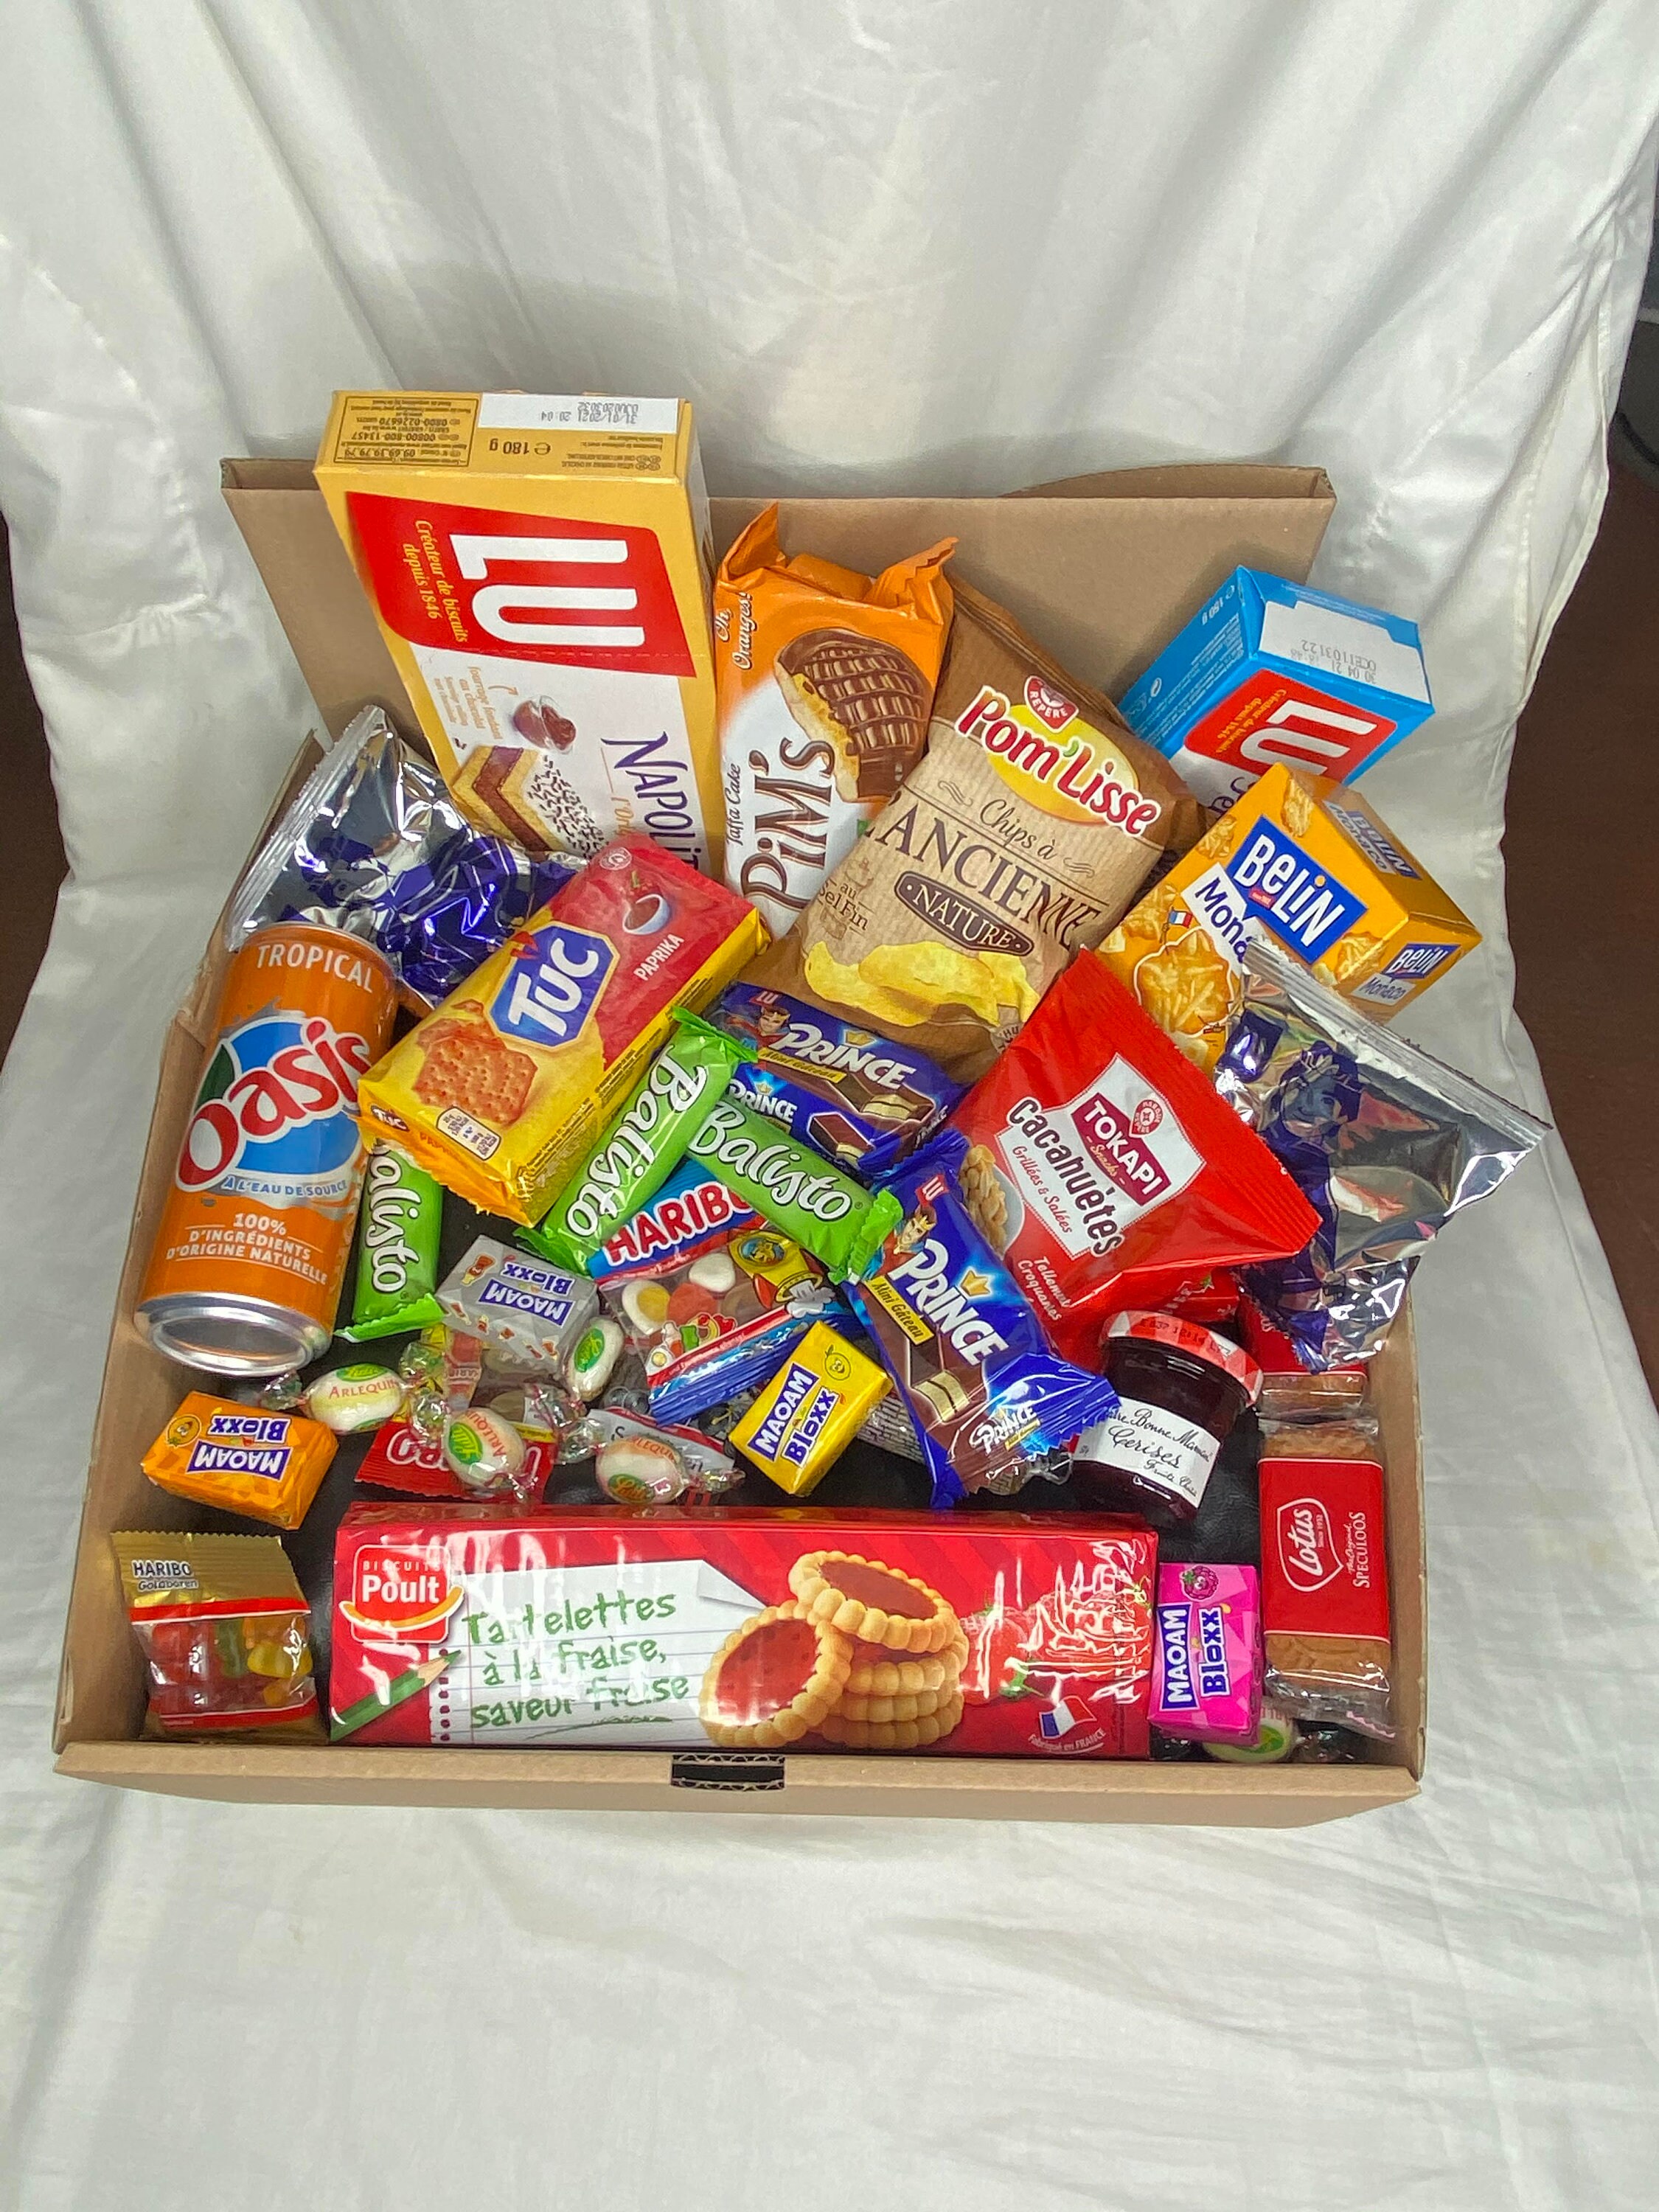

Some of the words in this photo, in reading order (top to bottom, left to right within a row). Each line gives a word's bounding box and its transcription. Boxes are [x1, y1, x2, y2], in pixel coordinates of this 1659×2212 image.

[502, 441, 529, 454] 180
[415, 520, 445, 578] Créateur
[403, 543, 430, 585] depuis
[420, 589, 442, 619] 1846
[437, 580, 453, 595] de
[449, 535, 645, 647] LU
[442, 599, 468, 642] biscuits
[734, 591, 757, 670] Oranges!
[1331, 662, 1342, 674] 21
[1348, 666, 1360, 679] 04
[1235, 698, 1262, 722] depuis
[956, 689, 1158, 835] Pom'Lisse
[1240, 700, 1377, 776] LU
[725, 763, 742, 796] Cake
[981, 800, 1032, 854] Chips
[1038, 840, 1057, 860] à
[839, 883, 857, 901] au
[863, 787, 1102, 950] 'ANCIENNE
[913, 887, 1012, 949] NATURE
[1194, 877, 1248, 962] Mona
[257, 943, 373, 993] TROPICAL
[633, 932, 684, 982] PAPRIKA
[507, 937, 600, 1037] TUC
[757, 990, 776, 1004] LU
[1361, 976, 1407, 1001] Monaco
[771, 1023, 917, 1089] PRINCE
[177, 1020, 369, 1186] Oasis
[726, 1079, 798, 1121] PRINCE
[566, 1043, 708, 1237] Balisto
[689, 1098, 852, 1222] Balisto
[1084, 1100, 1163, 1195] TOKAPI
[1090, 1144, 1119, 1178] Snacks
[237, 1178, 283, 1194] L'EAU
[285, 1182, 303, 1196] DE
[304, 1180, 348, 1195] SOURCE
[922, 1176, 945, 1200] LU
[1009, 1099, 1122, 1255] Cacahuètes
[1012, 1146, 1043, 1186] Grillées
[1038, 1186, 1048, 1195] &
[1044, 1195, 1073, 1234] Salées
[233, 1212, 287, 1235] 100%
[370, 1143, 420, 1294] alisto
[166, 1243, 246, 1260] D'ORIGINE
[249, 1247, 327, 1285] NATURELLE
[189, 1229, 311, 1262] D'INGRÉDIENTS
[502, 1261, 572, 1295] Bloxx
[888, 1238, 1009, 1366] PRINCE
[1018, 1259, 1062, 1321] Croquantes
[1034, 1256, 1070, 1308] Tellement
[485, 1285, 568, 1322] MAOAM
[872, 1282, 894, 1304] Mini
[891, 1301, 925, 1338] Gâteau
[327, 1376, 401, 1399] ARLEQUIN
[754, 1369, 813, 1456] MAOAM
[209, 1417, 289, 1443] Bloxx
[784, 1387, 840, 1469] Bloxx
[1107, 1424, 1181, 1469] Cerises
[1134, 1407, 1172, 1441] Bonne
[195, 1445, 283, 1473] MAOAM
[362, 1560, 441, 1572] BICUIT
[1287, 1509, 1323, 1576] Lotus
[1349, 1511, 1371, 1588] SPECULOOS
[132, 1561, 193, 1577] HARIBO
[362, 1574, 440, 1604] Poult
[462, 1590, 677, 1646] Tatelettes
[482, 1652, 505, 1686] à
[1166, 1609, 1193, 1705] MAOAM
[1200, 1608, 1231, 1697] Bloxx
[1075, 1728, 1107, 1750] FRANCE
